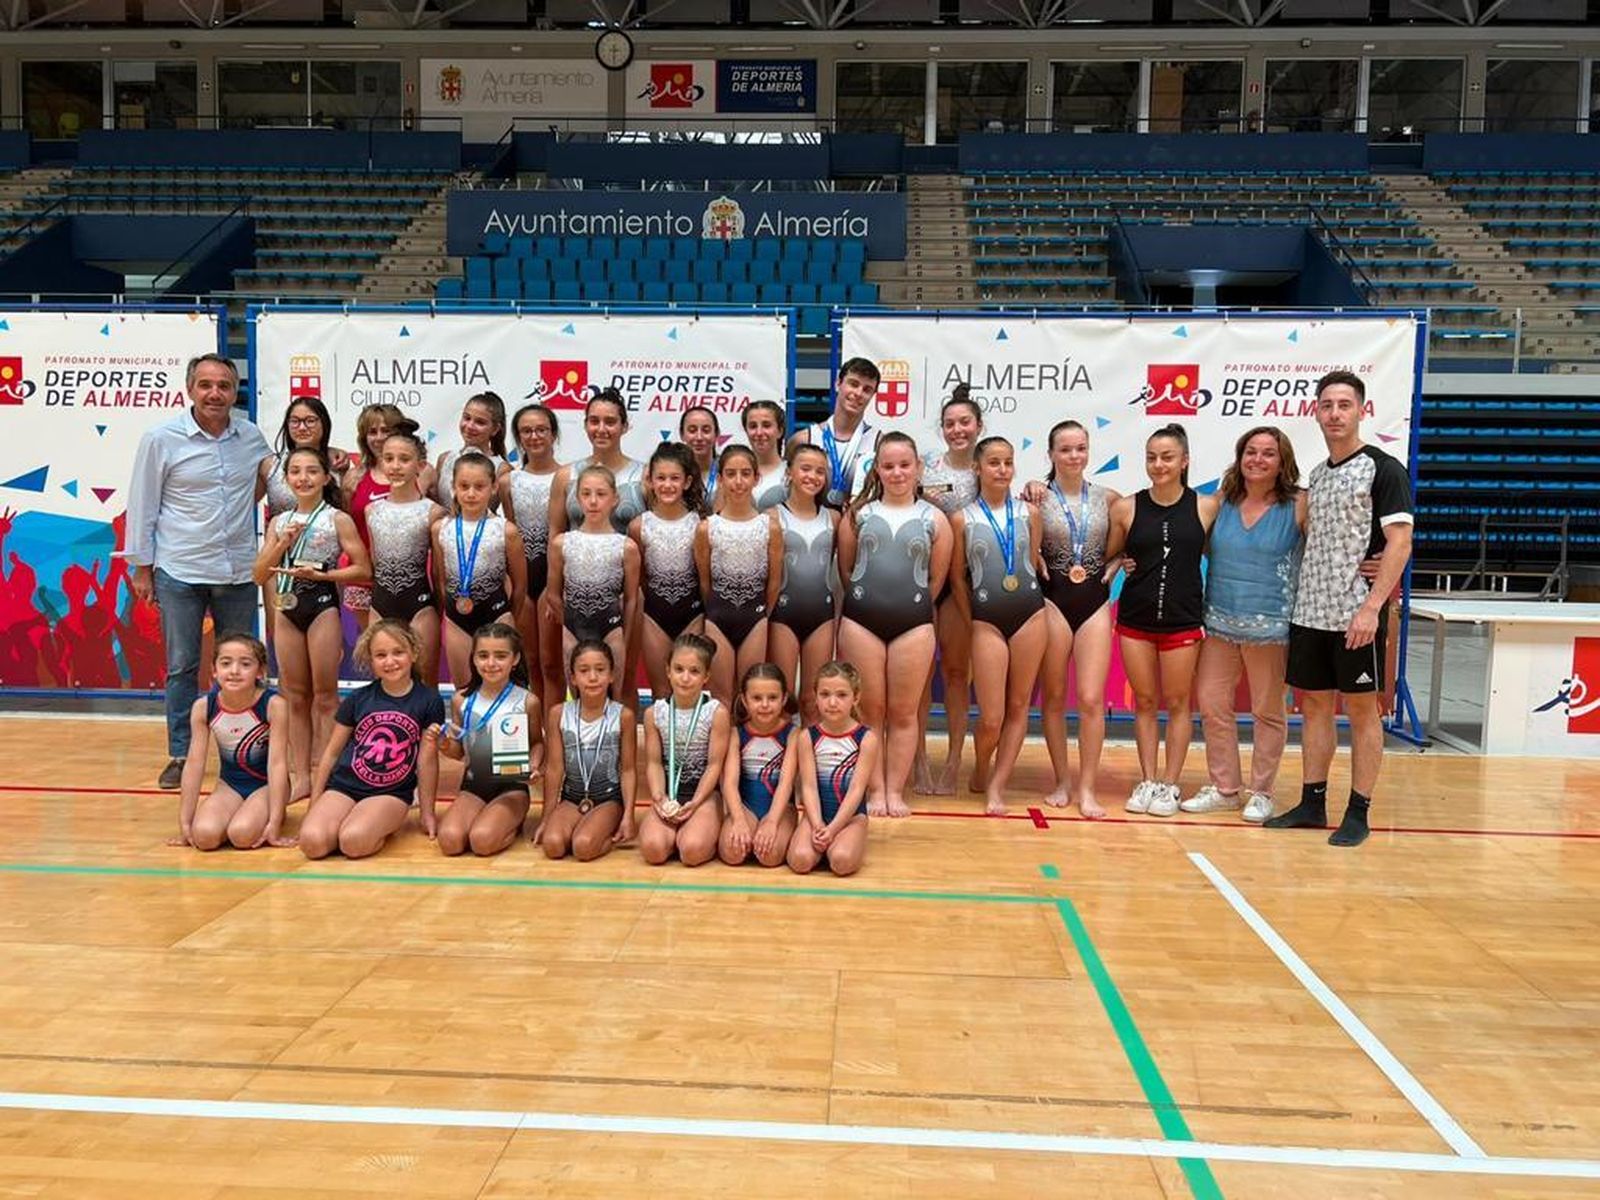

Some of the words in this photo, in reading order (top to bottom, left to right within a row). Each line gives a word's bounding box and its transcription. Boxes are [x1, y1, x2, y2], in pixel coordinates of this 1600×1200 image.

[481, 68, 595, 90] Ayuntamiento
[731, 71, 803, 81] DEPORTES
[732, 82, 748, 92] DE
[750, 82, 802, 92] ALMERIA
[483, 208, 694, 238] Ayuntamiento
[753, 208, 870, 237] Almería
[44, 355, 105, 366] PATRONATO
[109, 356, 163, 366] MUNICIPAL
[167, 357, 181, 366] DE
[351, 353, 490, 386] ALMERÍA
[610, 360, 673, 370] PATRONATO
[675, 361, 731, 370] MUNICIPAL
[734, 362, 749, 370] DE
[1223, 363, 1292, 373] PATRONATO
[1295, 364, 1354, 374] MUNICIPAL
[1358, 365, 1375, 374] DE
[44, 370, 168, 389] DEPORTES
[942, 356, 1093, 391] ALMERÍA
[611, 374, 734, 393] DEPORTES
[1222, 379, 1321, 397] DEPORT
[45, 389, 76, 407] DE
[83, 390, 186, 408] ALMERIA
[350, 389, 422, 407] CIUDAD
[648, 395, 752, 413] ALMERIA
[1221, 399, 1255, 417] DE
[1262, 400, 1376, 418] ALMA
